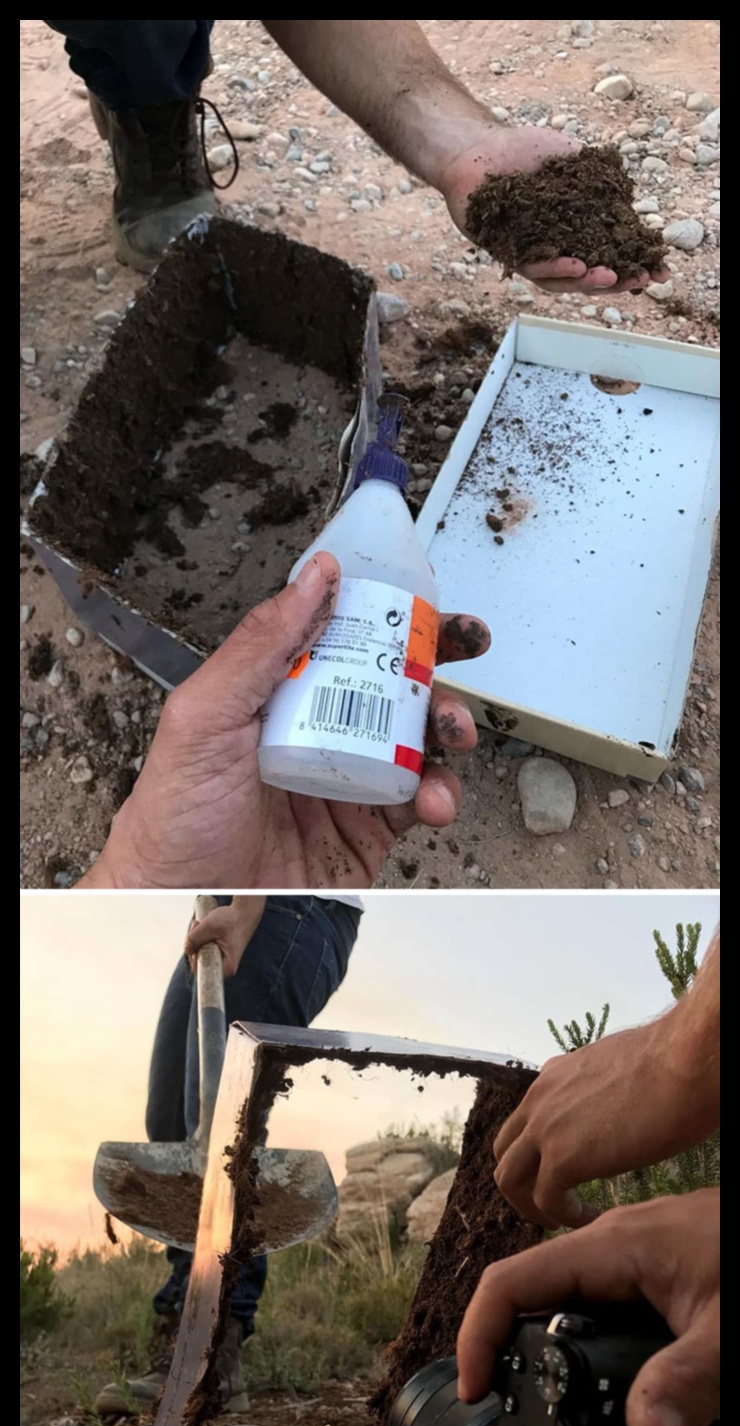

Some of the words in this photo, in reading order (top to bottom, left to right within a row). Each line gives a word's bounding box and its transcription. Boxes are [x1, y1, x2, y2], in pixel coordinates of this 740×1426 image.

[333, 675, 357, 688] Ref.:
[359, 679, 384, 694] 2716
[310, 722, 348, 736] 414646
[353, 729, 388, 743] 271694
